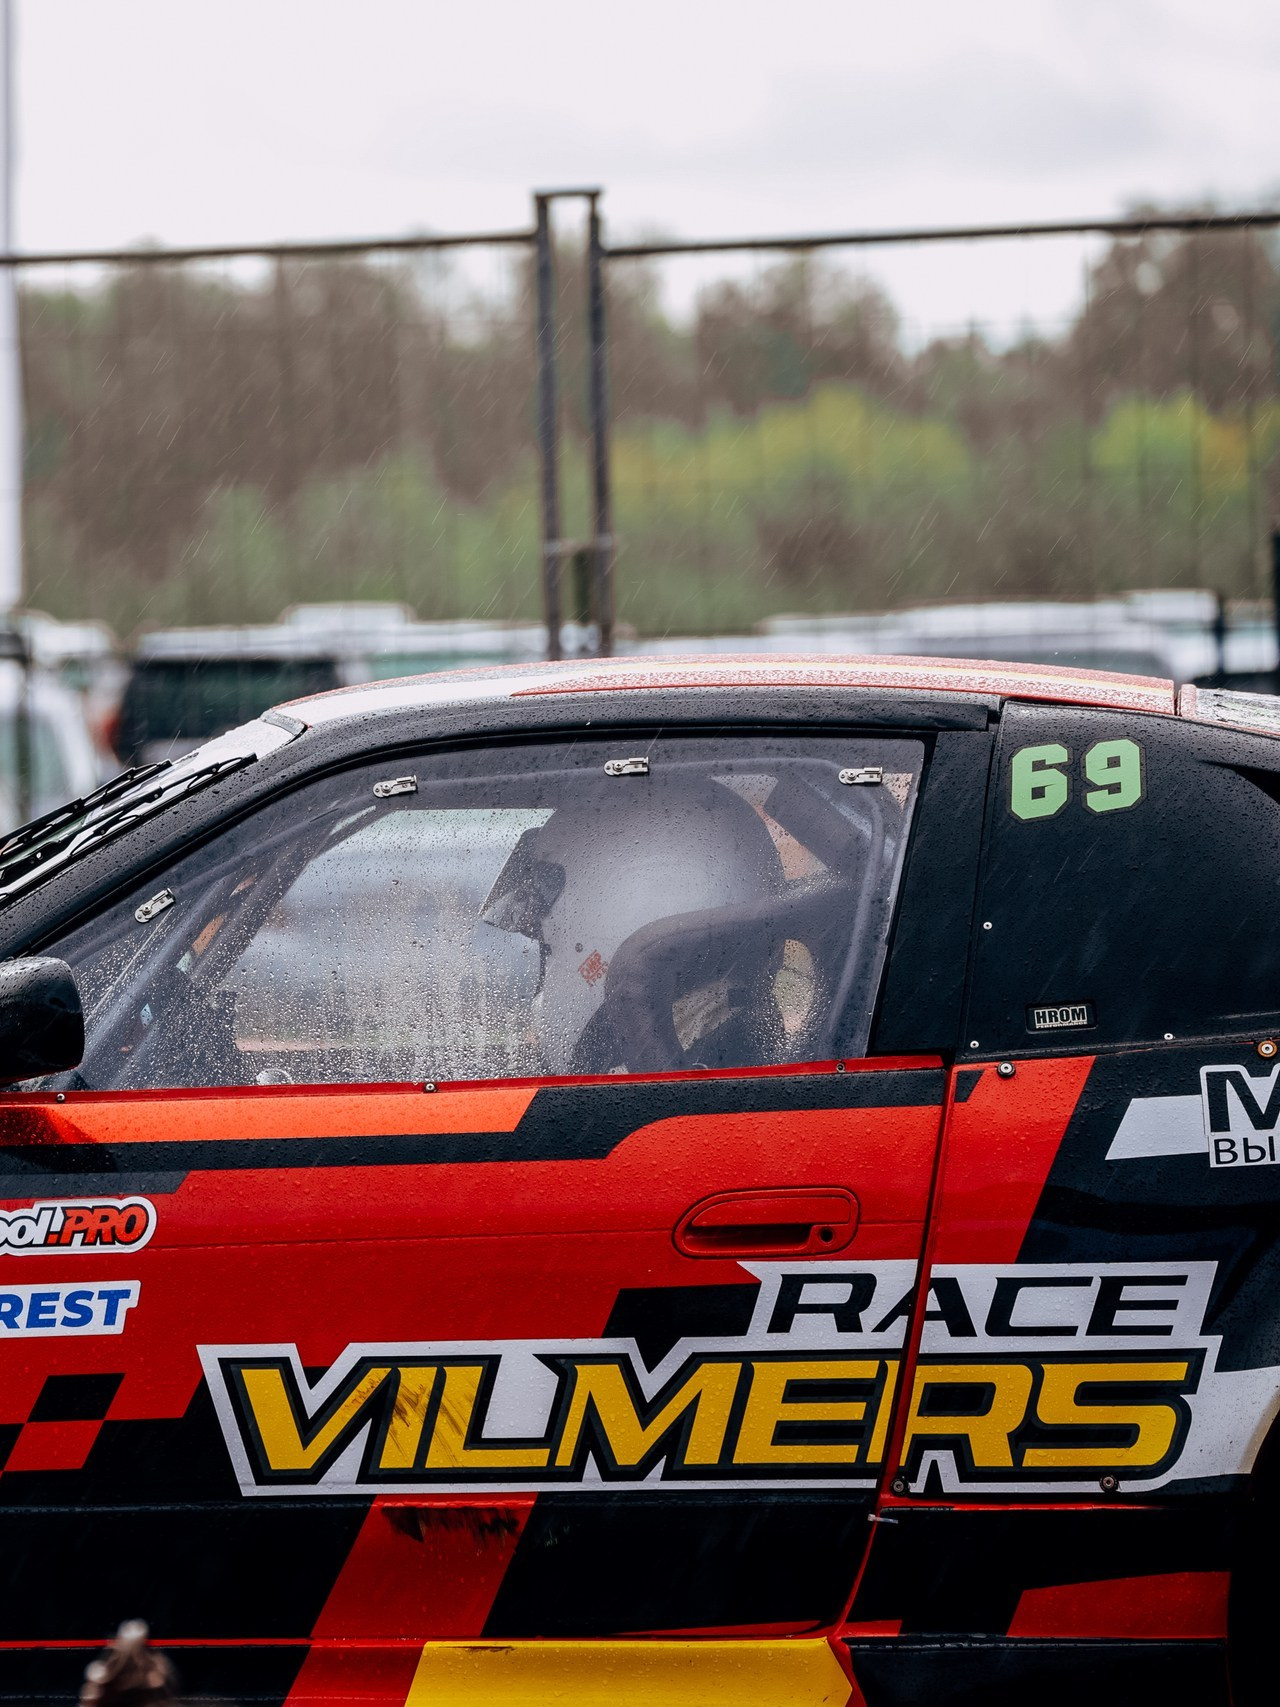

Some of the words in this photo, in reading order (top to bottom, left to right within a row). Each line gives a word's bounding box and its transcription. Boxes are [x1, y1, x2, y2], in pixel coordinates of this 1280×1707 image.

[1011, 738, 1142, 821] 69
[1034, 1005, 1088, 1026] HROM
[766, 1273, 1189, 1338] RACE
[220, 1349, 1202, 1485] VILMERS
